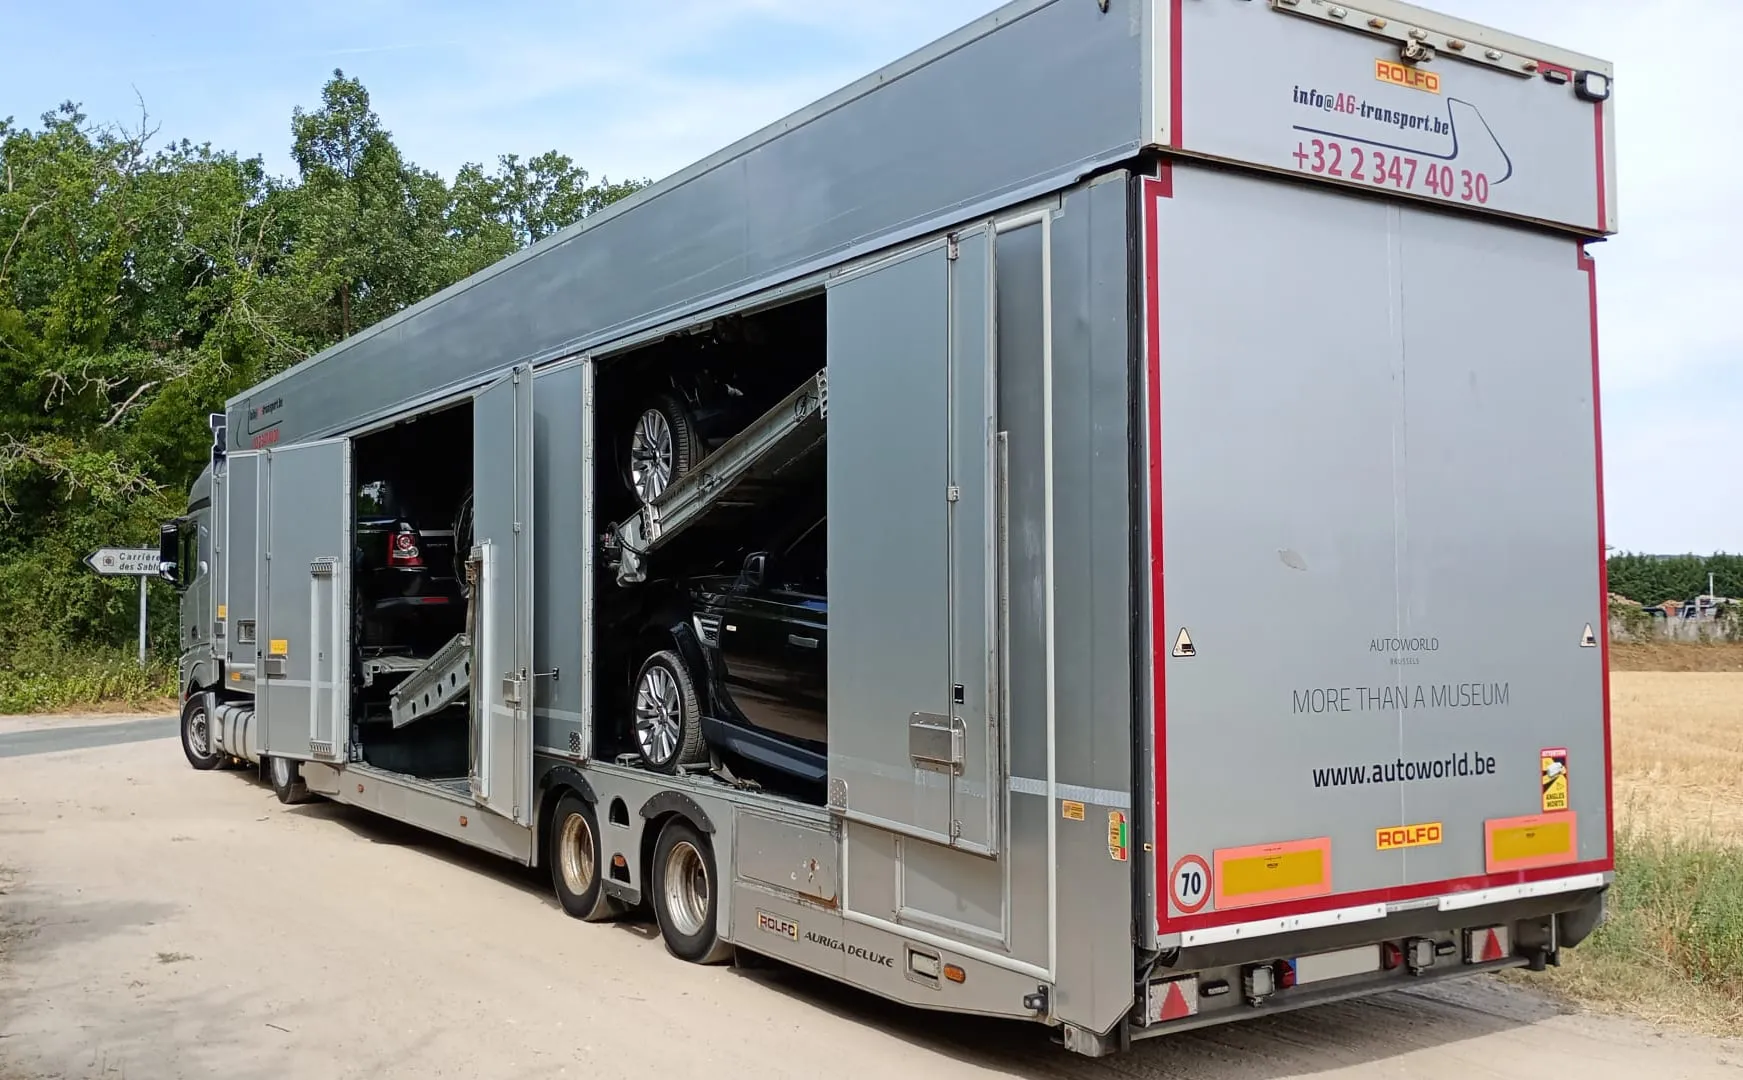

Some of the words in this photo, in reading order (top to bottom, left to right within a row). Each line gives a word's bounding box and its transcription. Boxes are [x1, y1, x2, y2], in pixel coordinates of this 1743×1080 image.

[1376, 62, 1438, 91] ROLFO
[1292, 85, 1449, 135] info@A6-transport.be
[1292, 139, 1342, 177] +32
[1350, 147, 1365, 181] 2
[1372, 151, 1418, 190] 347
[1424, 163, 1454, 197] 40
[1461, 170, 1489, 204] 30
[119, 562, 135, 570] des
[1369, 637, 1439, 652] AUTOWORLD
[1292, 687, 1351, 714] MORE
[1356, 684, 1408, 711] THAN
[1413, 685, 1426, 709] A
[1431, 682, 1510, 708] MUSEUM
[1312, 751, 1496, 787] www.autoworld.be
[1378, 826, 1440, 847] ROLFO
[1181, 871, 1201, 896] 70
[759, 914, 796, 937] ROLFO
[803, 931, 846, 953] AURIGA
[847, 944, 895, 968] DELUXE
